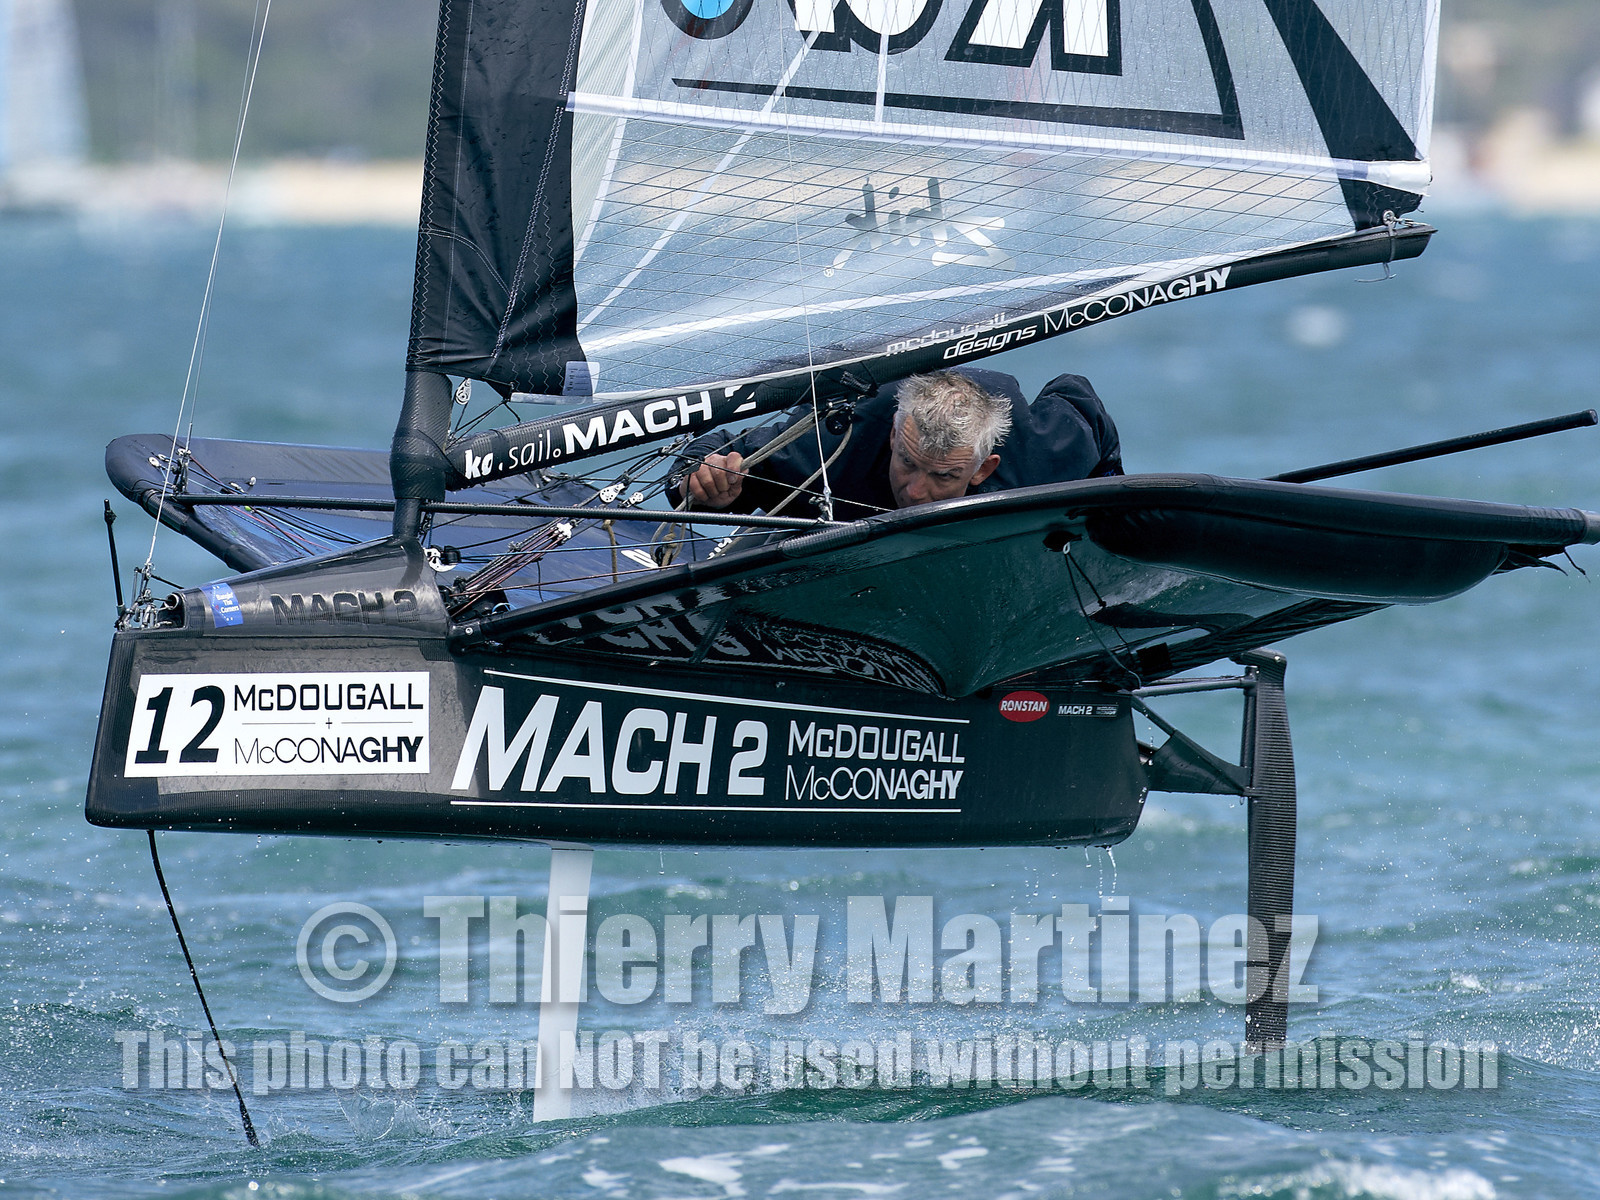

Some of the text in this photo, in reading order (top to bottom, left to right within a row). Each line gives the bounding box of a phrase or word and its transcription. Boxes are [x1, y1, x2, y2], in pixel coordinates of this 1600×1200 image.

[1044, 266, 1232, 334] McCONAGHY
[943, 325, 1037, 360] designs
[562, 390, 713, 455] MACH
[270, 590, 385, 626] MACH
[234, 683, 424, 711] McDOUGALL
[1000, 700, 1048, 712] RONSTAN
[1058, 705, 1085, 715] MACH
[1085, 706, 1093, 715] 2
[135, 685, 225, 764] 12
[450, 685, 768, 796] MACH 2
[787, 720, 965, 764] McDOUGALL
[234, 736, 424, 764] McCONAGHY
[785, 764, 964, 801] McCONAGHY
